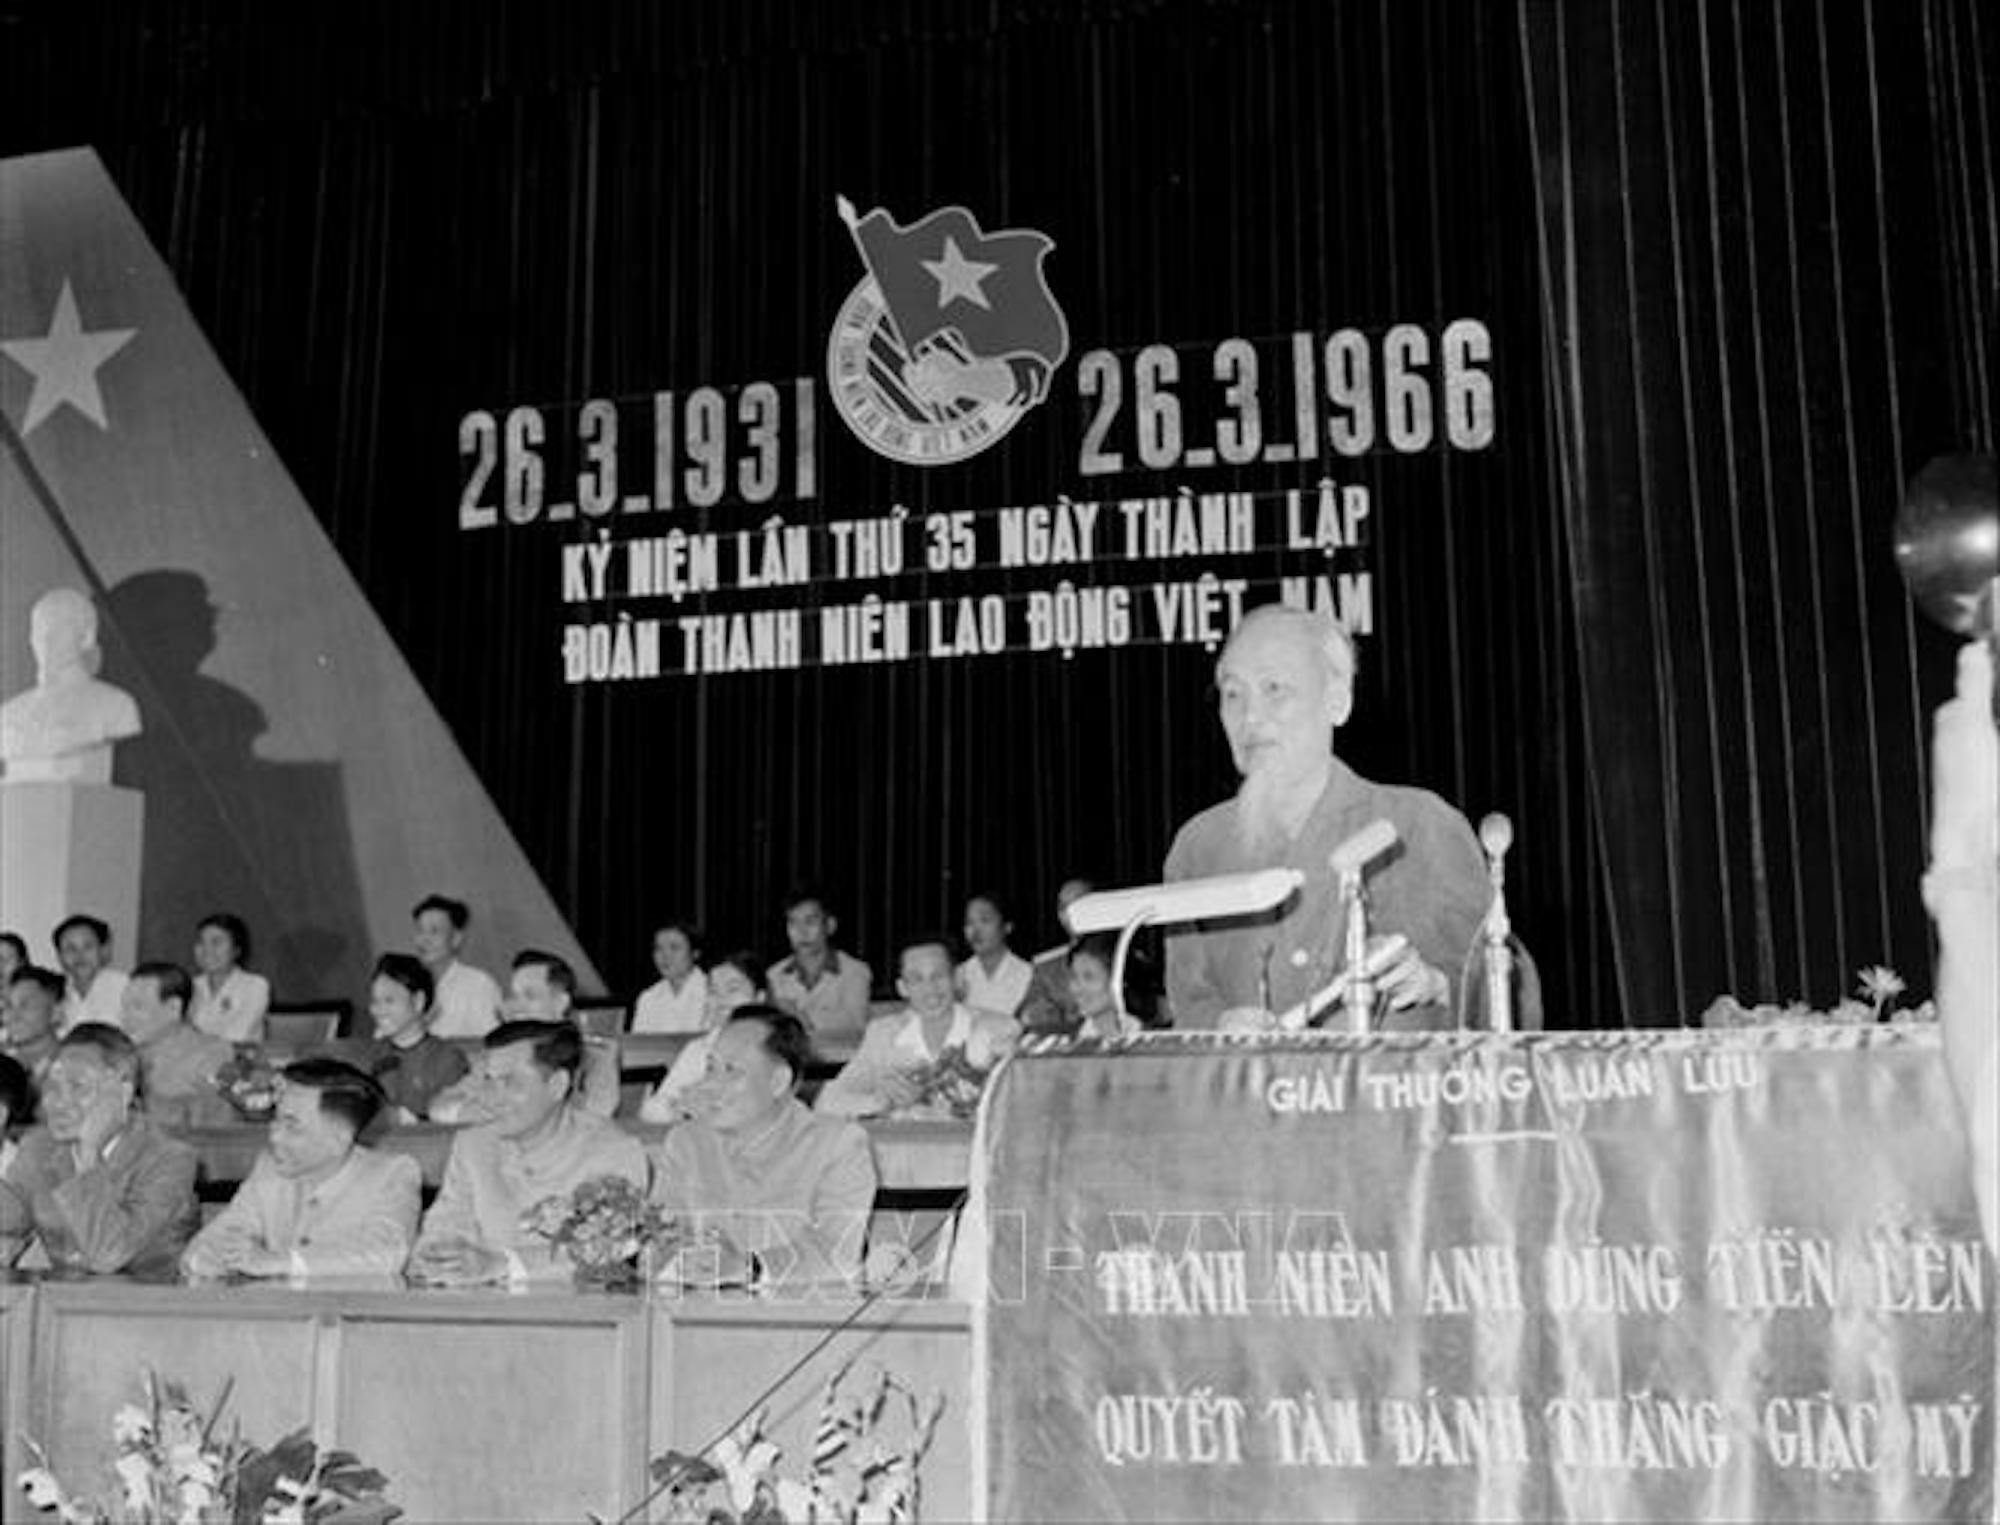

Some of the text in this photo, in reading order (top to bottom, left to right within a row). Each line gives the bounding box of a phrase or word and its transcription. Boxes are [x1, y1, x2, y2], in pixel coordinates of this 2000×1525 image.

[628, 527, 718, 603] NIỆM
[926, 510, 976, 572] 35
[998, 494, 1099, 568] NGÀY
[1120, 486, 1255, 560] THÀNH
[1287, 477, 1371, 558] LẬP
[561, 611, 661, 684] ĐOÀN
[679, 608, 801, 675] THANH
[821, 592, 910, 665] NIÊN
[928, 594, 1006, 659] LAO
[1026, 580, 1130, 660] ĐỘNG
[1152, 571, 1248, 653] VIỆT
[1097, 1247, 1250, 1316] THANH
[1275, 1241, 1394, 1317] NIÊN
[1424, 1245, 1526, 1315] ANH
[1097, 1385, 1246, 1466] QUYẾT
[1764, 1388, 1879, 1481] GIẶC
